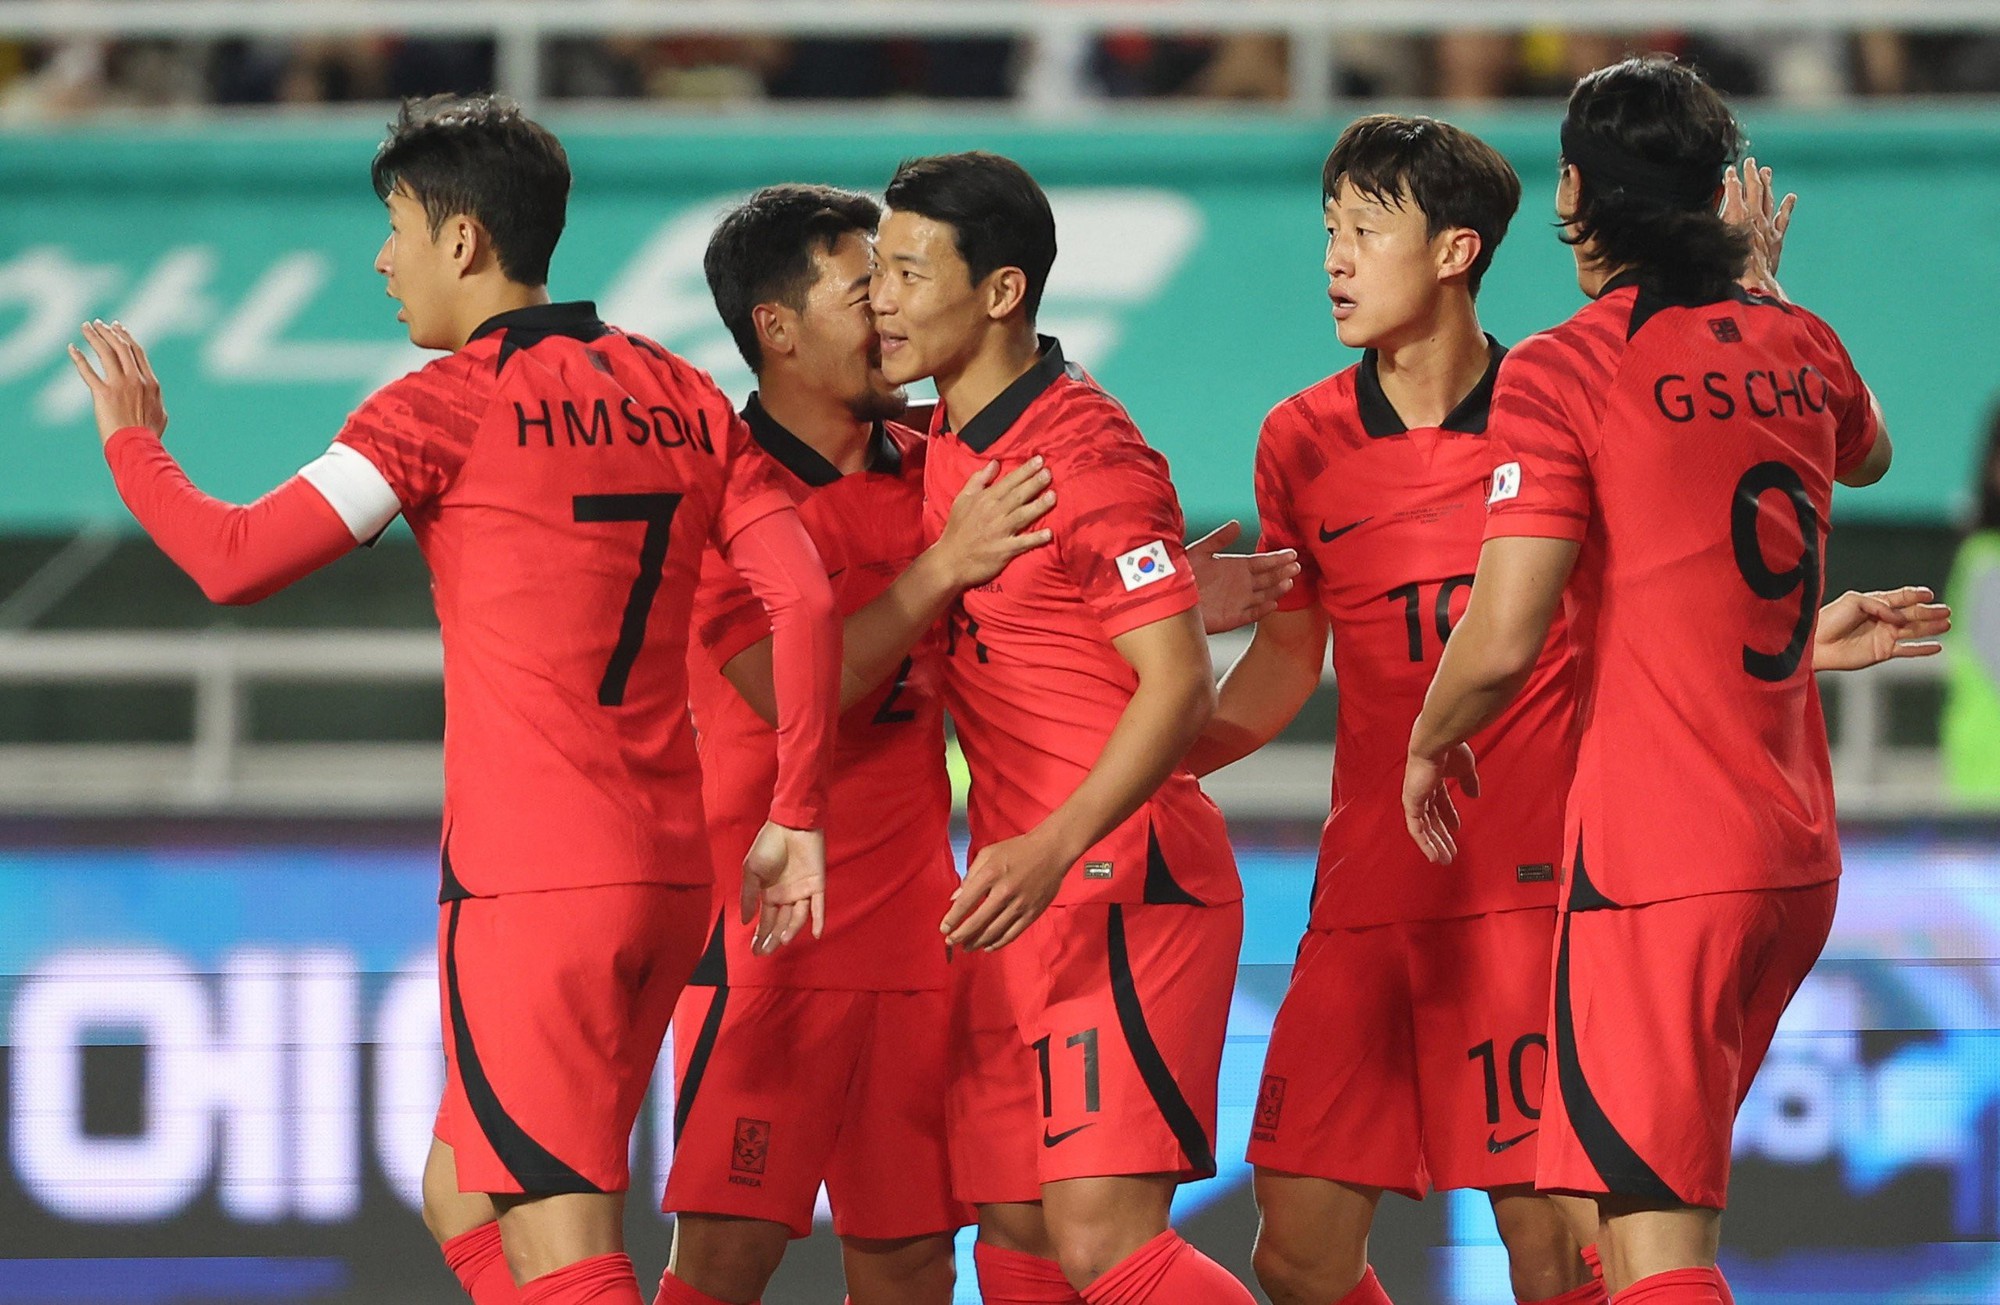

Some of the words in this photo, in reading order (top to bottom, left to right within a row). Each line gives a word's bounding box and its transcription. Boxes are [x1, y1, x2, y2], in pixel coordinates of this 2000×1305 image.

[620, 396, 716, 455] SON
[1745, 364, 1829, 419] CHO
[572, 492, 685, 707] 7
[1731, 460, 1820, 682] 9
[1031, 1027, 1101, 1118] 11
[1467, 1032, 1549, 1124] 10
